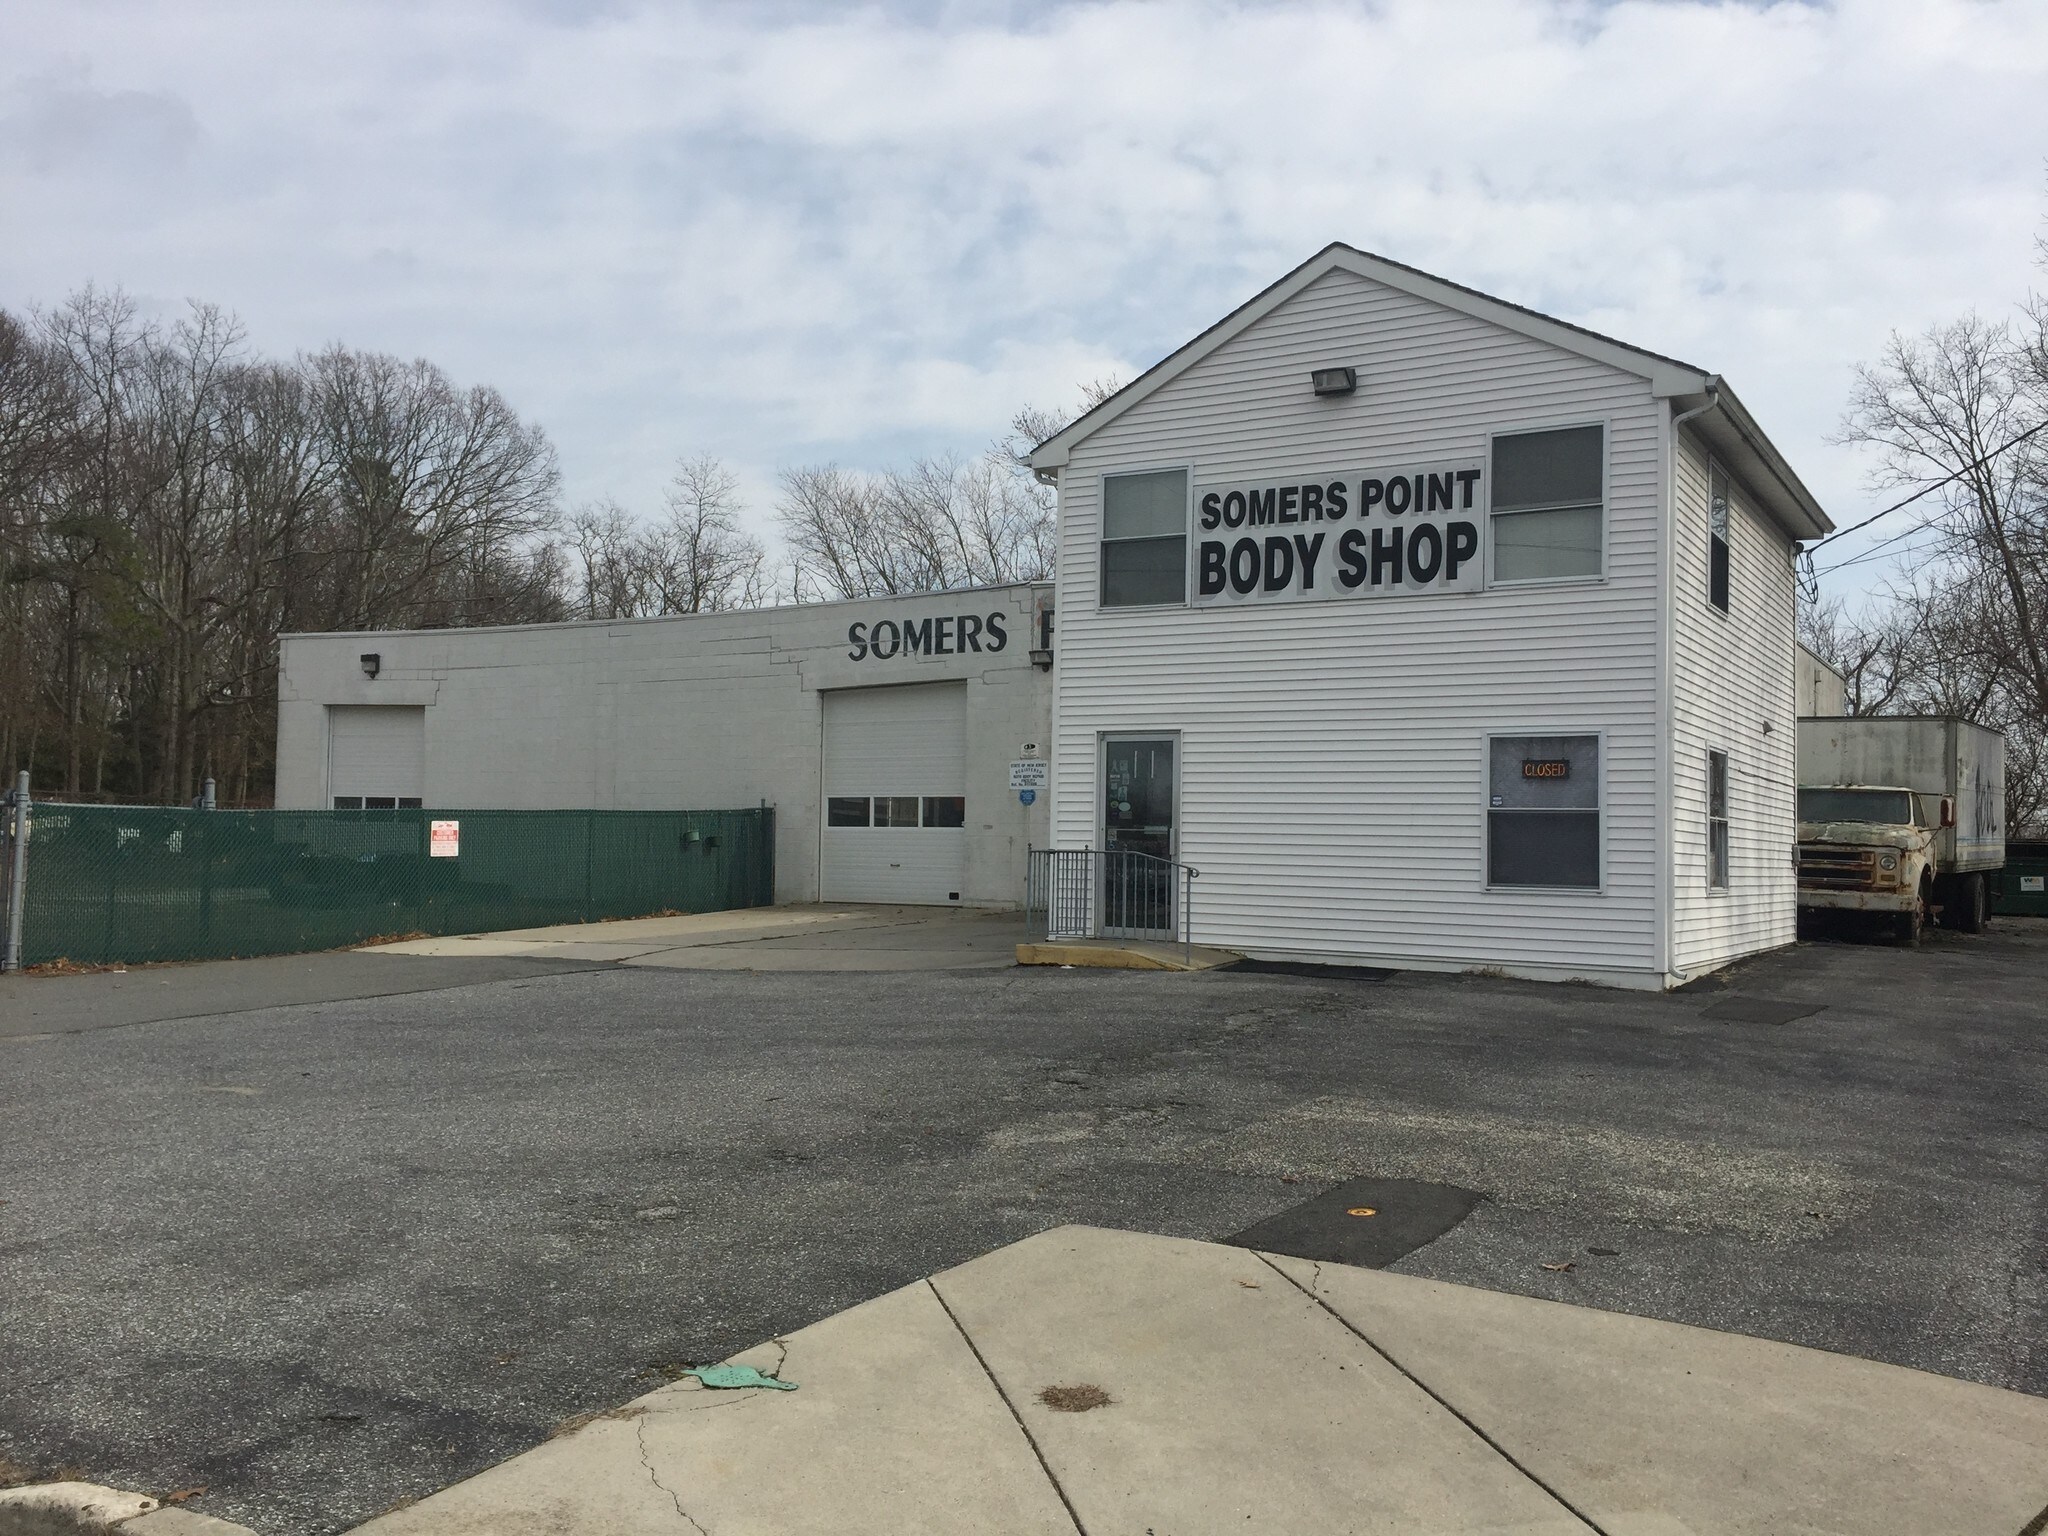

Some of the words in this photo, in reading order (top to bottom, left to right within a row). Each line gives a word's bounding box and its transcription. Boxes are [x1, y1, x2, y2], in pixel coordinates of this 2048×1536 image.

[1201, 481, 1348, 530] SOMERS
[1360, 469, 1481, 517] POINT
[1200, 532, 1326, 595] BODY
[1338, 521, 1478, 588] SHOP
[848, 611, 1008, 662] SOMERS
[1525, 763, 1566, 777] CLOSED
